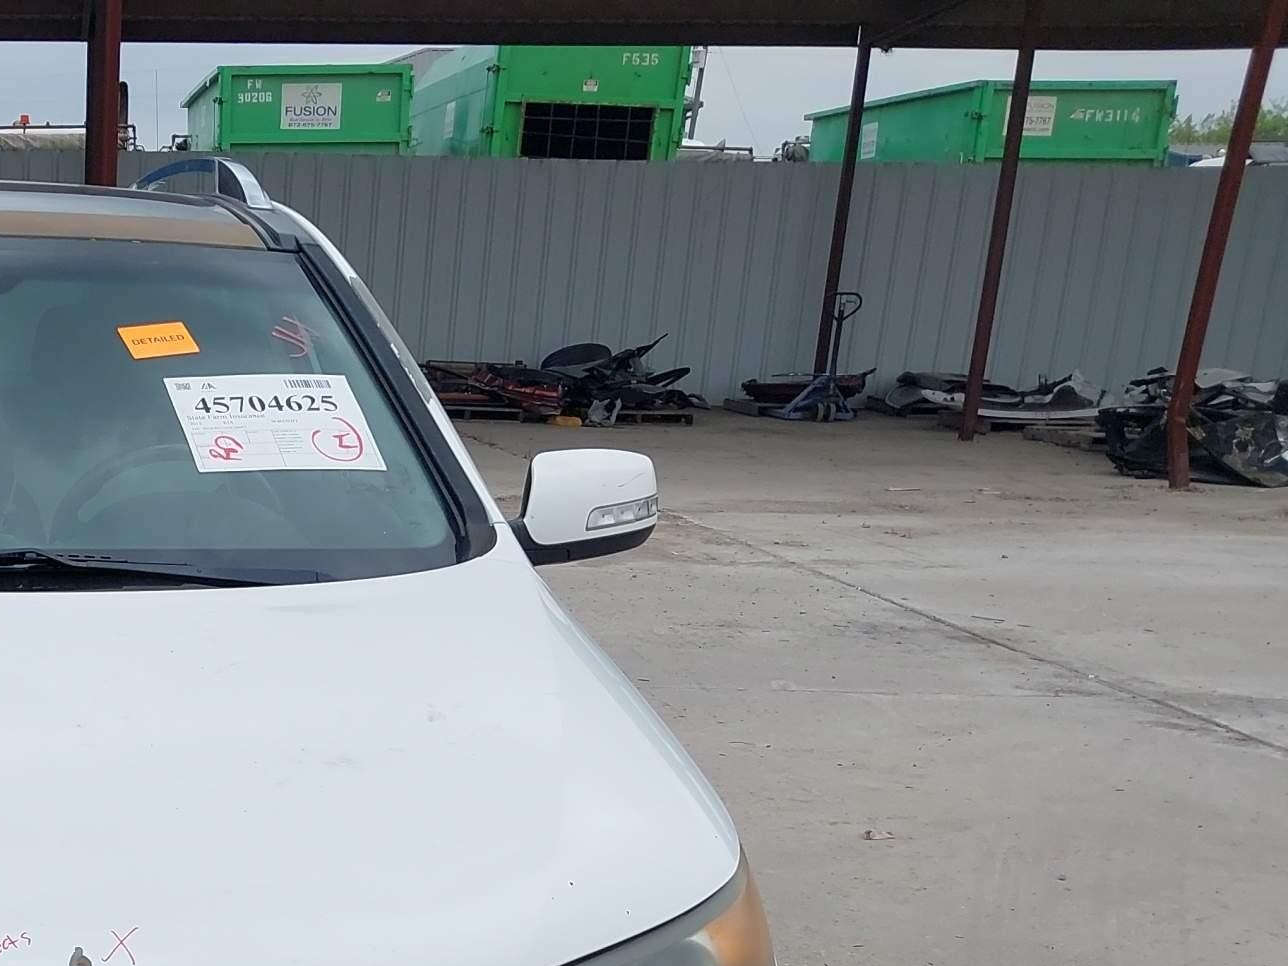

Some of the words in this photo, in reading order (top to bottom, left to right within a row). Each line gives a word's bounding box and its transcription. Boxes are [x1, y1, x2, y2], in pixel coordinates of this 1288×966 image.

[284, 105, 338, 117] FUSION
[131, 334, 185, 346] DETAILED
[195, 395, 339, 414] 45704625
